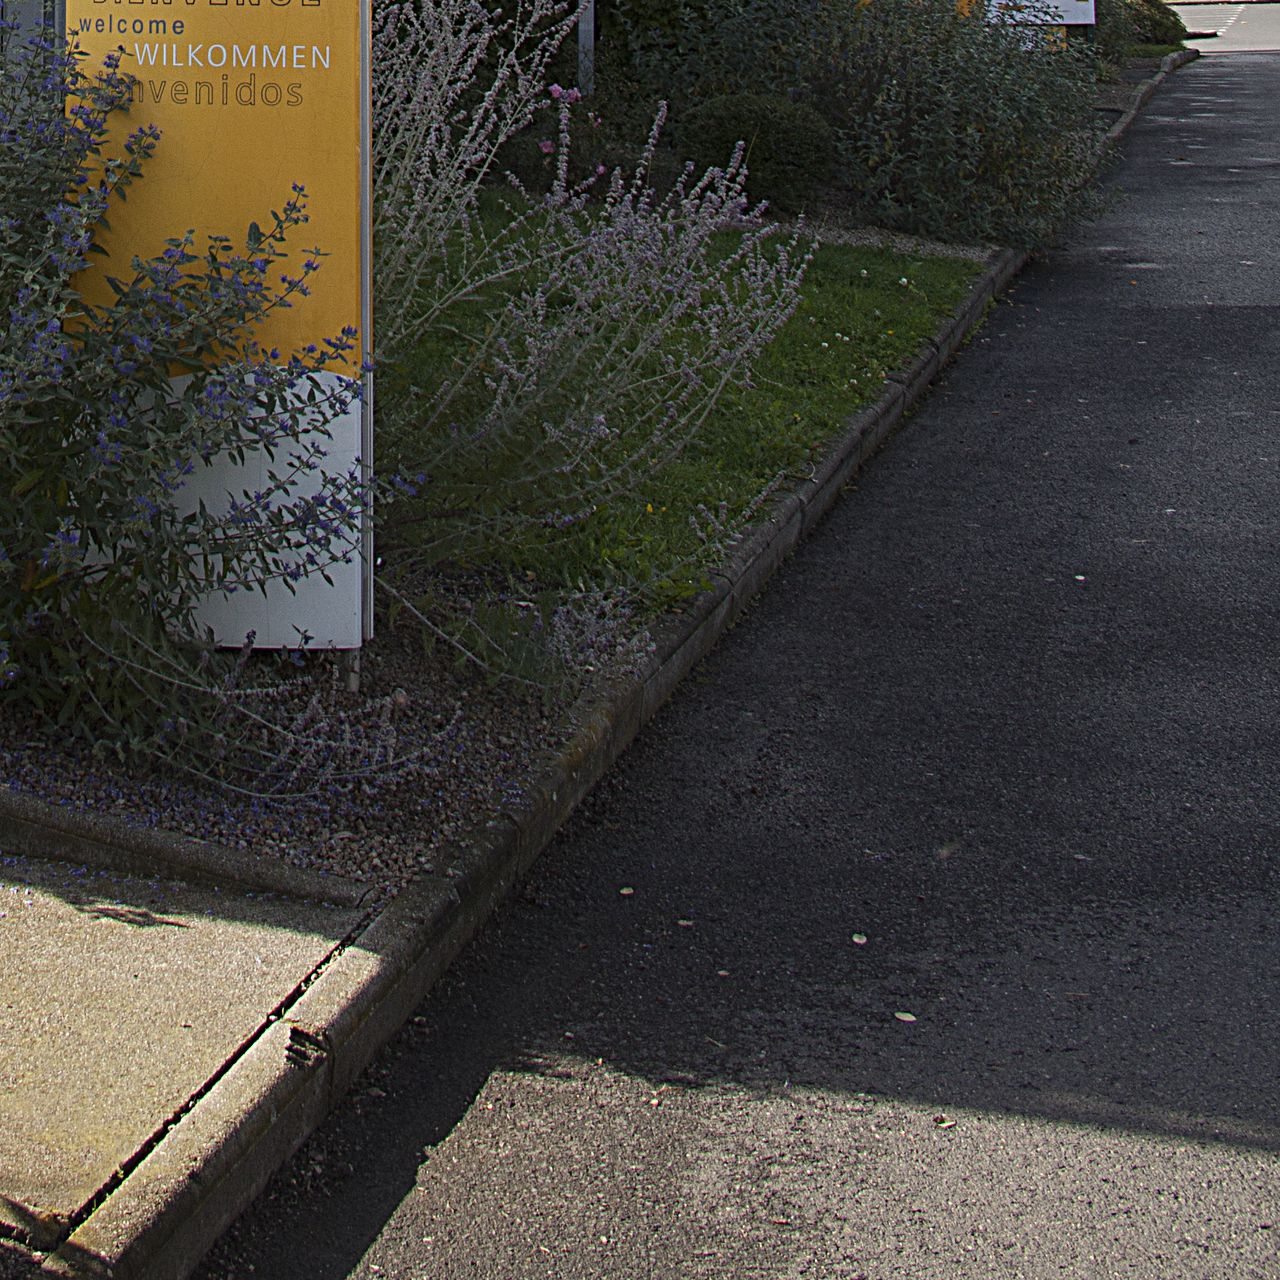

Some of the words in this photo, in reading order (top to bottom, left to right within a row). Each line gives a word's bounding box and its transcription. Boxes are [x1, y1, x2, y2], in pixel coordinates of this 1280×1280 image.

[79, 14, 185, 35] welcome
[134, 43, 331, 69] WILKOMMEN
[80, 68, 304, 107] nvenidos
